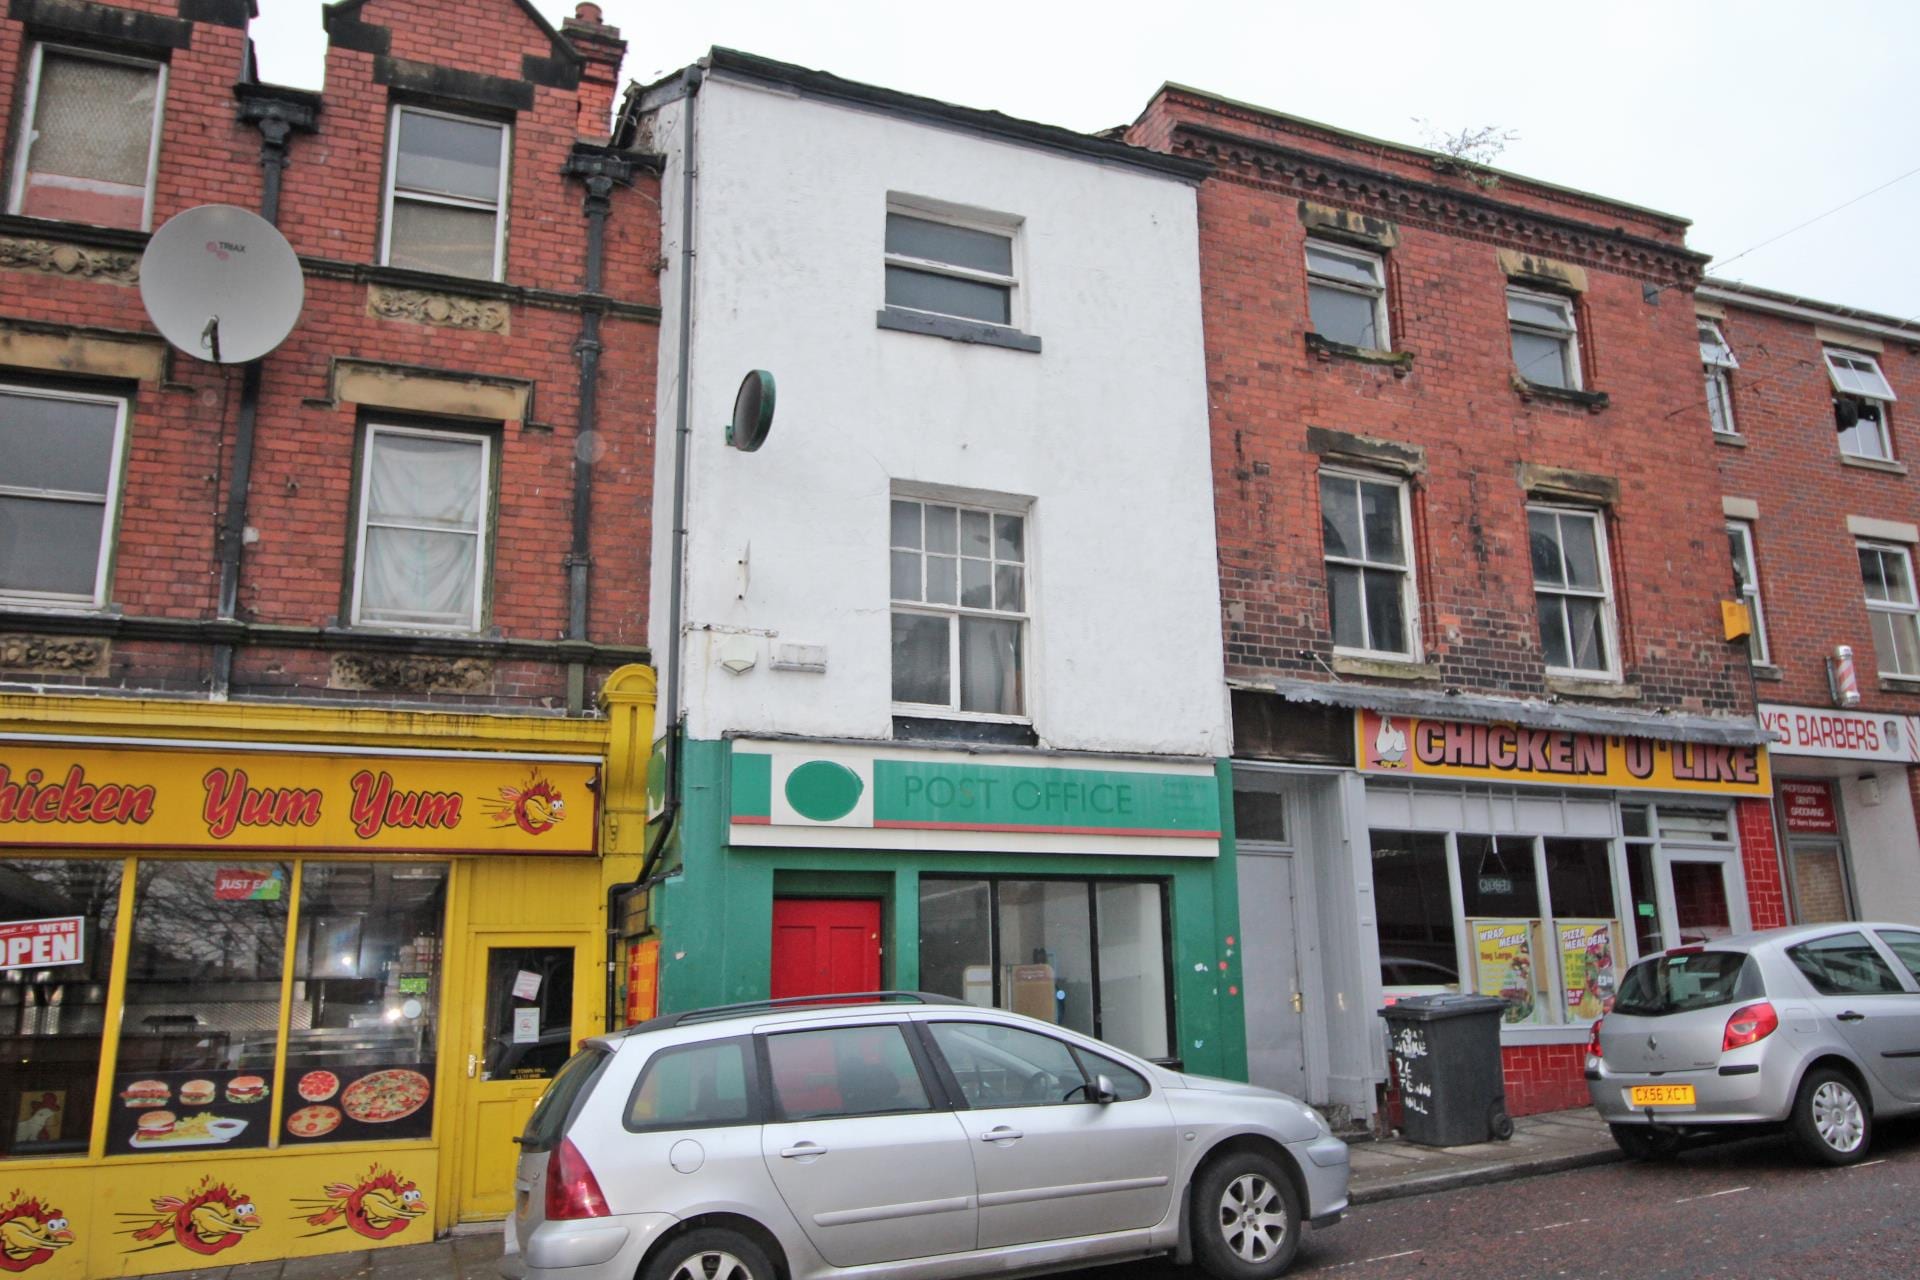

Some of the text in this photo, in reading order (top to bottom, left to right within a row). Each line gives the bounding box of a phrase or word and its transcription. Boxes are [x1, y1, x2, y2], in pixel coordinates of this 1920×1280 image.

[219, 241, 246, 253] TRIAX
[1795, 714, 1880, 751] BARBERS
[1415, 720, 1607, 776] CHICKEN
[1671, 741, 1759, 784] LIKE
[903, 774, 998, 810] POST
[1012, 780, 1133, 815] OFFICE
[203, 767, 323, 839] Yum
[350, 769, 463, 839] Yum
[1790, 806, 1825, 817] GROOMING
[219, 879, 276, 891] JUST EAT
[38, 921, 77, 933] WE'RE
[1480, 927, 1504, 941] WRAP
[1562, 928, 1585, 941] PIZZA
[1499, 933, 1525, 948] MEALS
[1564, 934, 1607, 950] MEAL DEAL
[0, 933, 76, 966] PEN
[1636, 1087, 1688, 1102] CX56 XCT
